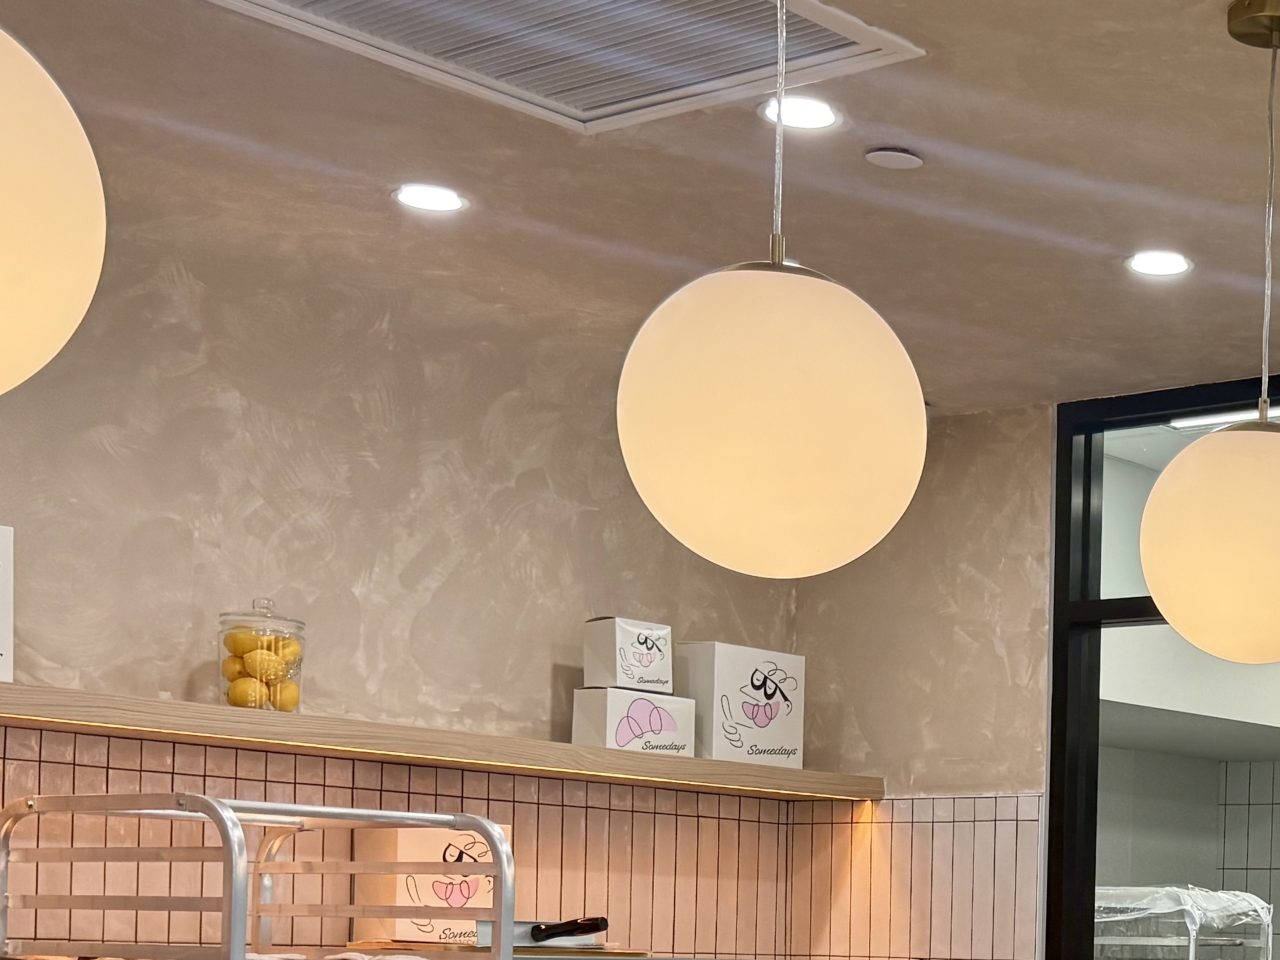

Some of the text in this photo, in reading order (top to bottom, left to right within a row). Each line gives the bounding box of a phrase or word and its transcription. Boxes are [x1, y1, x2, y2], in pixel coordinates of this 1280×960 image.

[641, 741, 687, 751] Somedays
[747, 745, 798, 758] Somedays
[439, 928, 478, 940] Some
